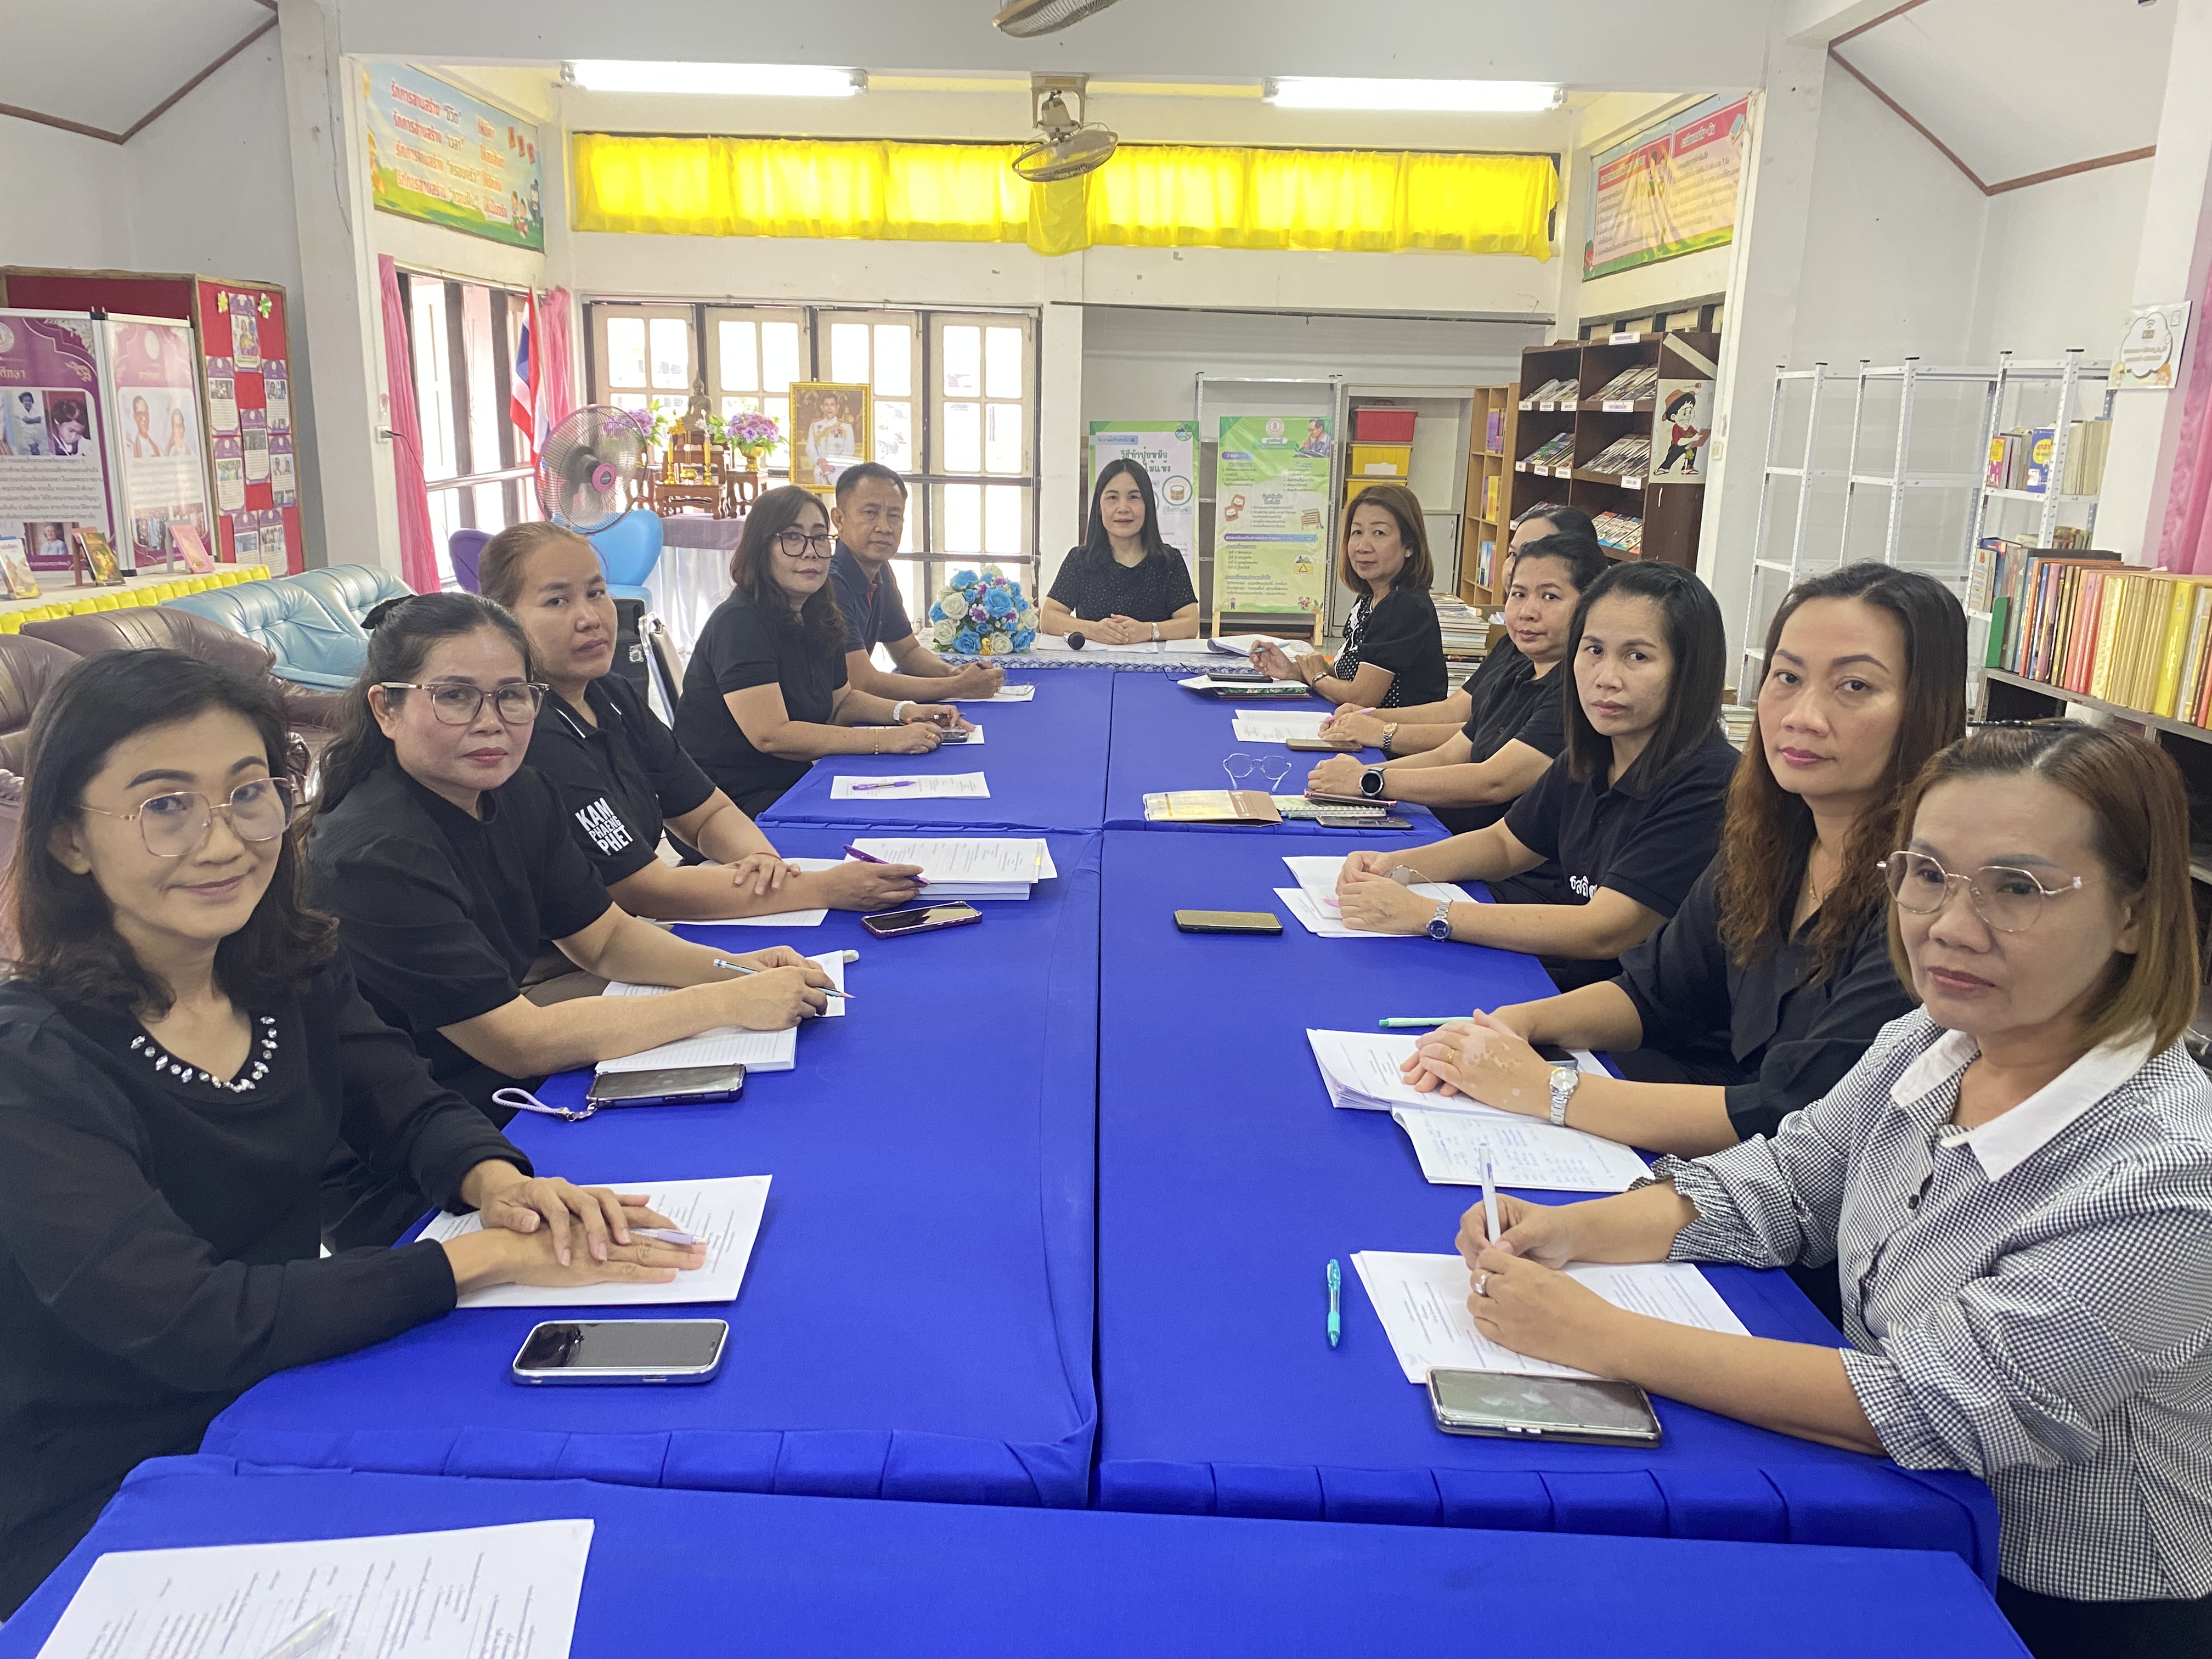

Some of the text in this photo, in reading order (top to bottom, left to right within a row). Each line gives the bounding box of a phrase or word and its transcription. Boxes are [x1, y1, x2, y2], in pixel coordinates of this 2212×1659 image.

[575, 797, 614, 831] KAM
[588, 815, 622, 842] PHAENG
[596, 824, 633, 856] PHET
